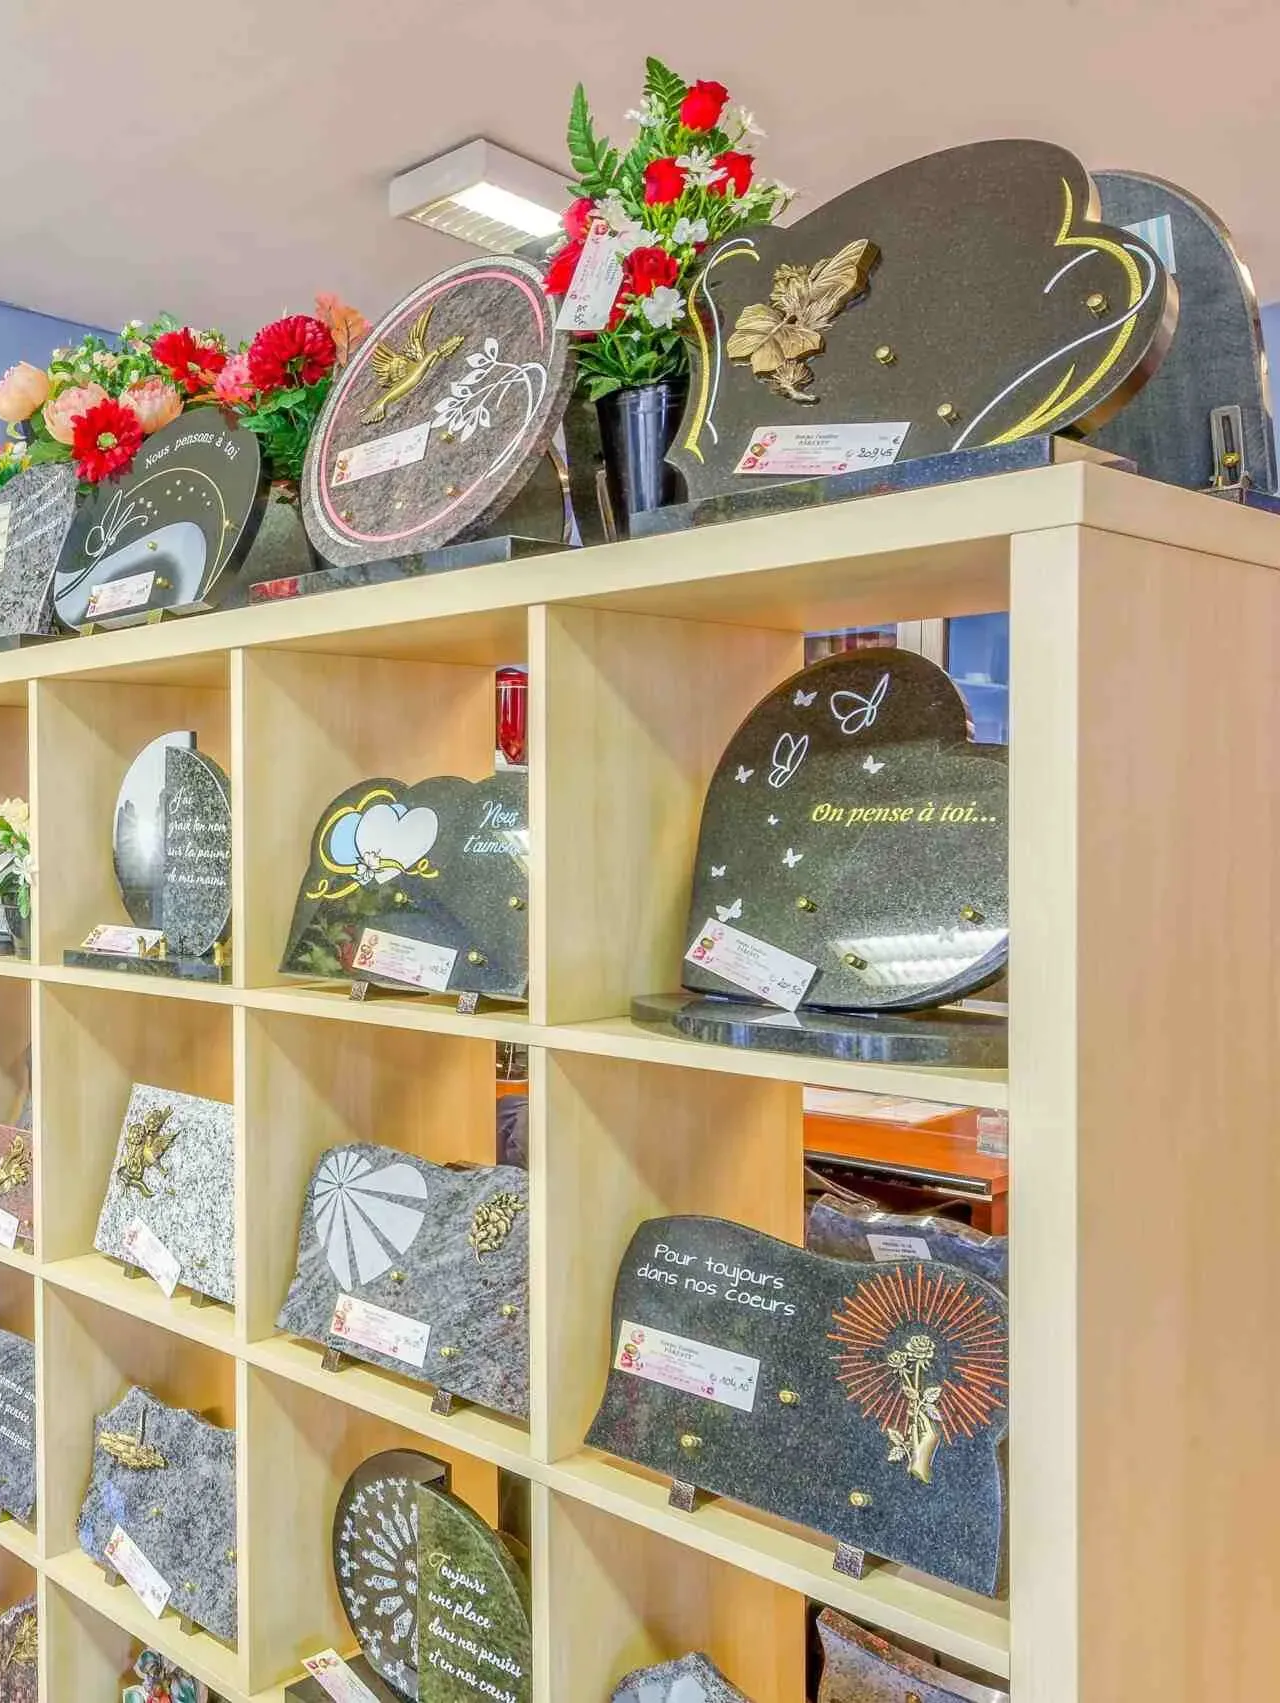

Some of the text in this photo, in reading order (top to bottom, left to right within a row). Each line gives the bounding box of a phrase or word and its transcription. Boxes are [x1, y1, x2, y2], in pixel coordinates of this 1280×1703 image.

[144, 445, 170, 469] Nous
[174, 432, 215, 451] pensons
[223, 441, 240, 460] toi
[480, 800, 519, 829] Nous
[811, 802, 844, 822] On
[845, 806, 914, 828] pense
[917, 801, 934, 822] à
[654, 1243, 785, 1290] Pour toujours
[636, 1263, 796, 1316] dans nos coeurs
[428, 1552, 487, 1595] Toujours
[428, 1591, 492, 1629] une place
[428, 1616, 522, 1678] dans nos pensées
[428, 1648, 442, 1668] et
[456, 1667, 478, 1687] nos
